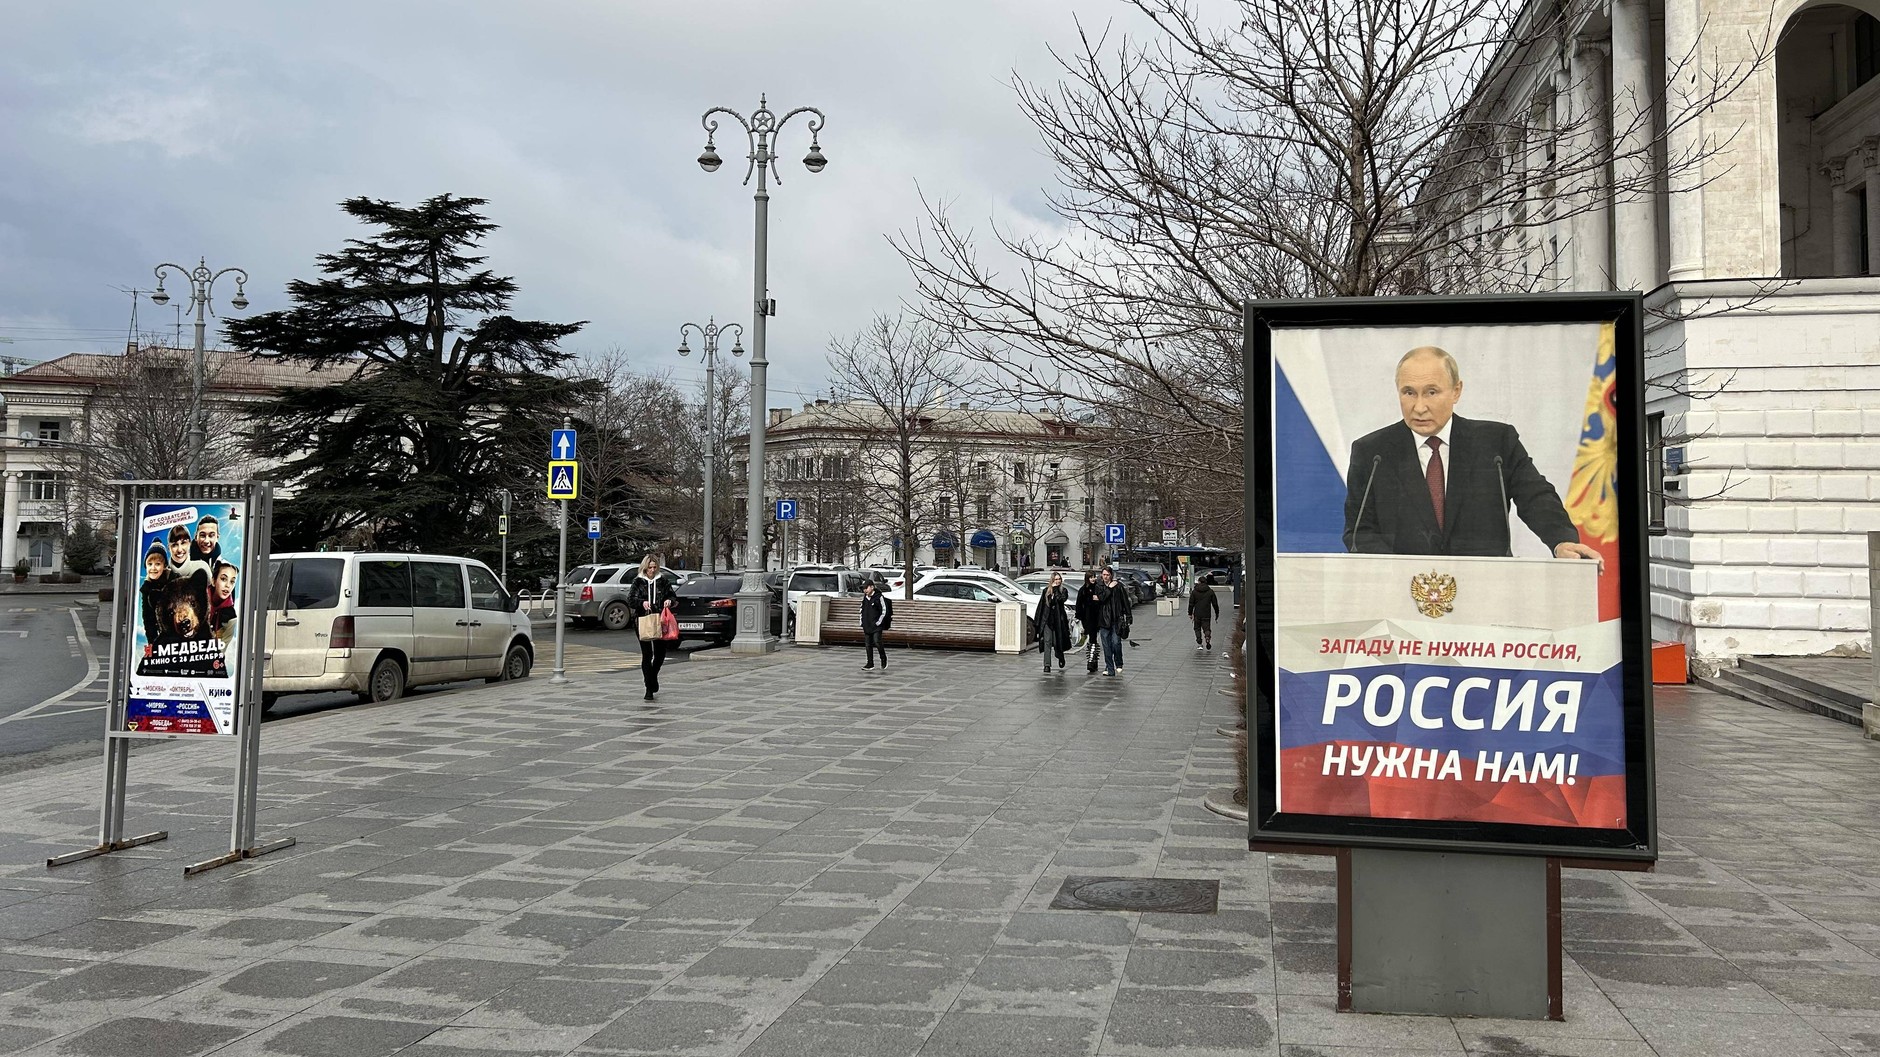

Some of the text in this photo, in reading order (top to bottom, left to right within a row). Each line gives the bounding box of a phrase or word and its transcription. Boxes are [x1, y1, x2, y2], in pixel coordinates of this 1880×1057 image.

[157, 510, 191, 522] СОЗДАТЕЛЕЙ
[781, 502, 792, 518] P
[1109, 526, 1121, 542] P
[143, 639, 226, 658] Я-МЕДВЕДЬ
[1319, 639, 1581, 662] ЗАПАДУ НЕ НУЖНА РОССИЯ,
[150, 657, 170, 665] КИНО
[189, 652, 224, 662] ДЕКАБРЯ
[213, 659, 224, 669] 6+
[1321, 674, 1583, 733] РОССИЯ
[1322, 745, 1579, 786] НУЖНА НАМ!
